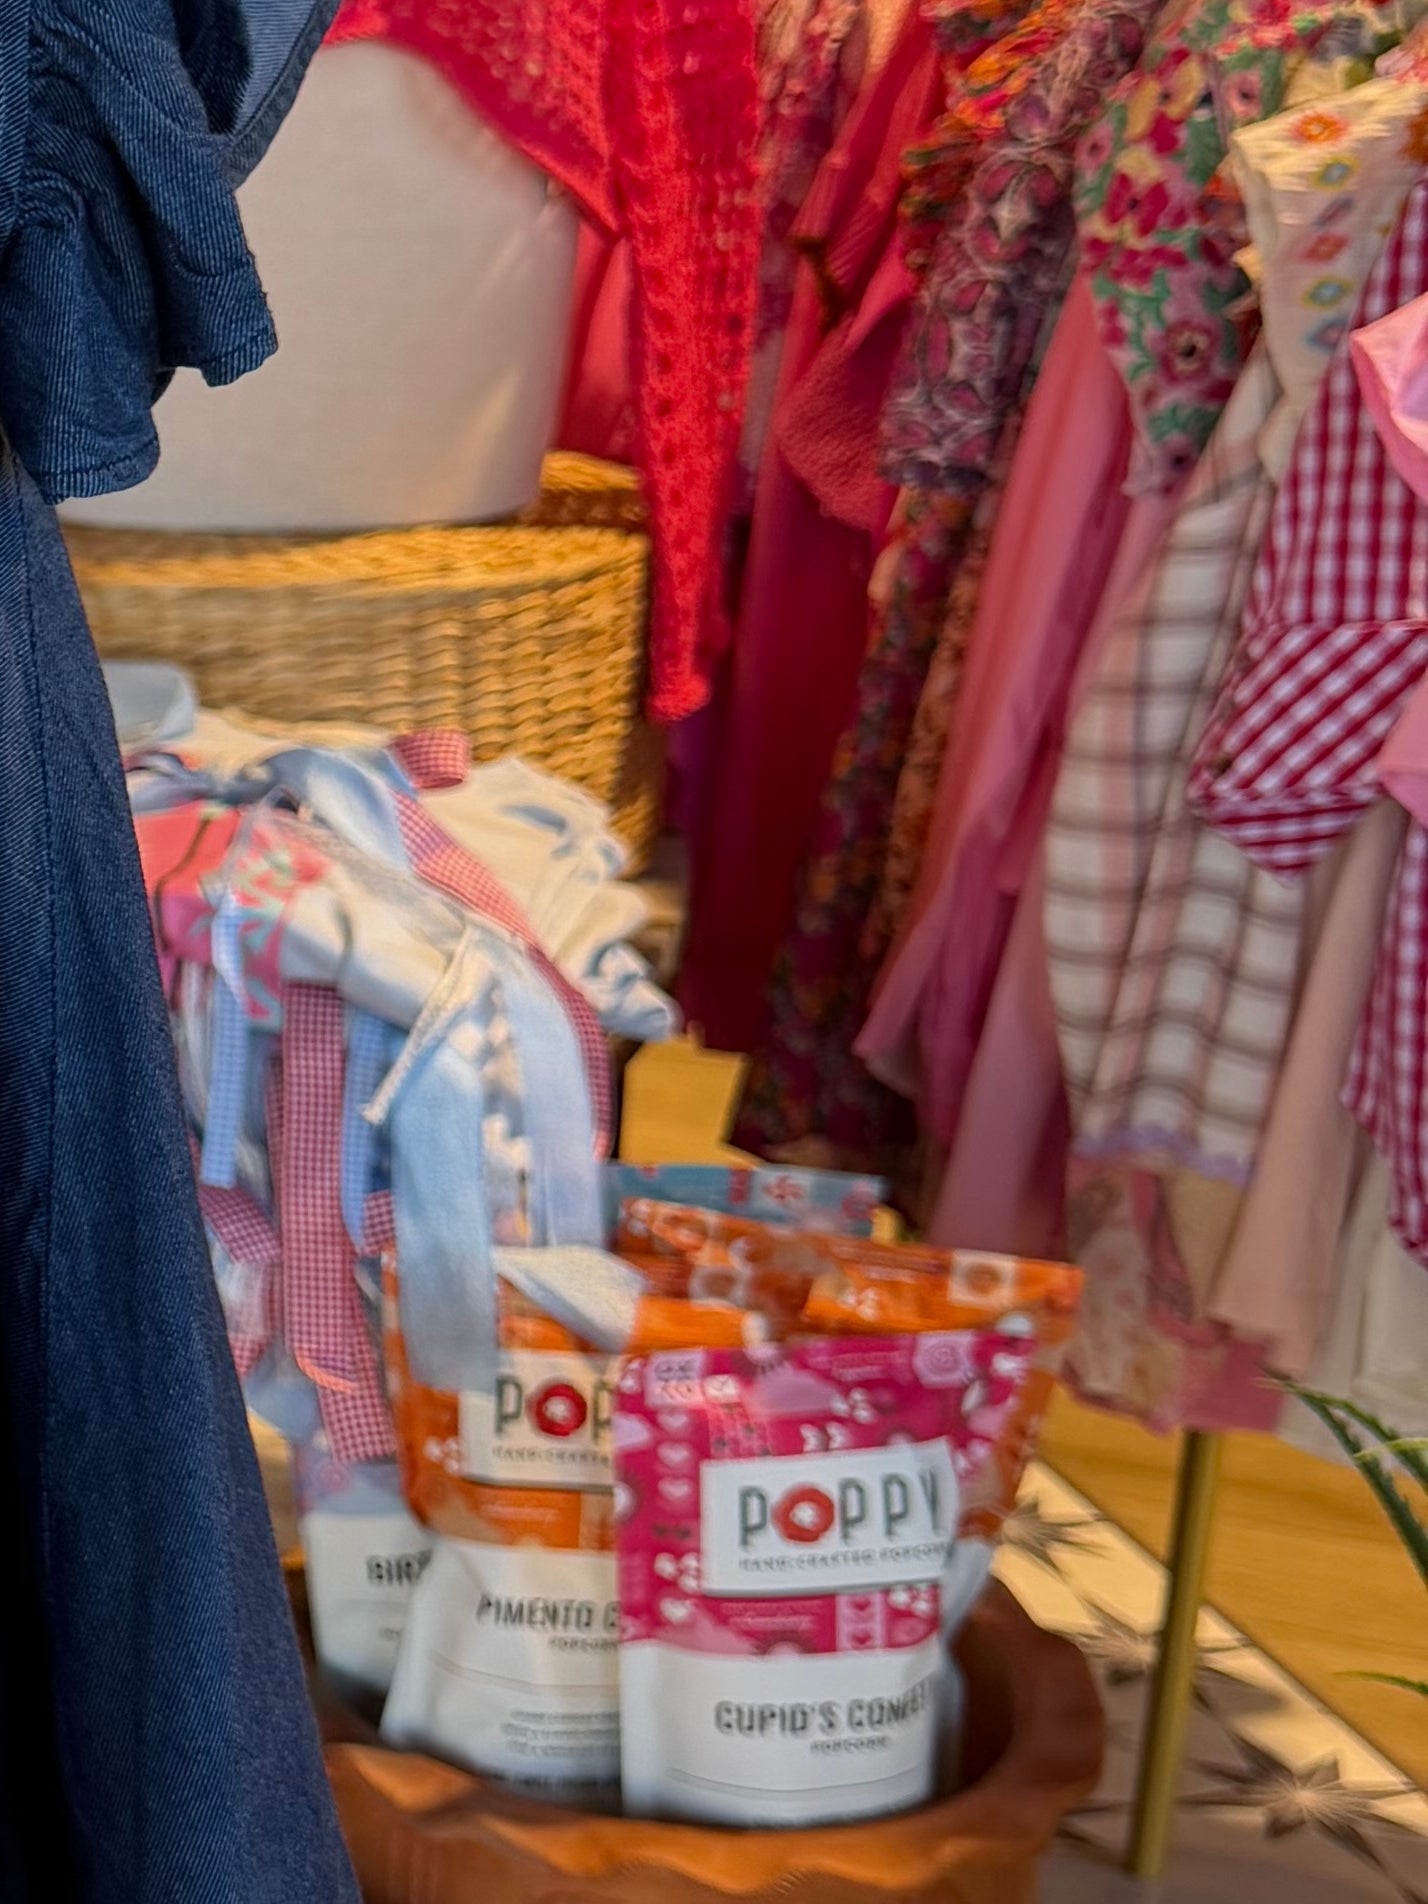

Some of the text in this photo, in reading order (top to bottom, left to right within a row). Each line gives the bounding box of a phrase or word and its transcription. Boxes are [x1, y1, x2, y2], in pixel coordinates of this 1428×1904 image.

[739, 1468, 940, 1552] POPPY
[477, 1594, 594, 1628] PIMENTO
[714, 1700, 841, 1736] CUPID'S
